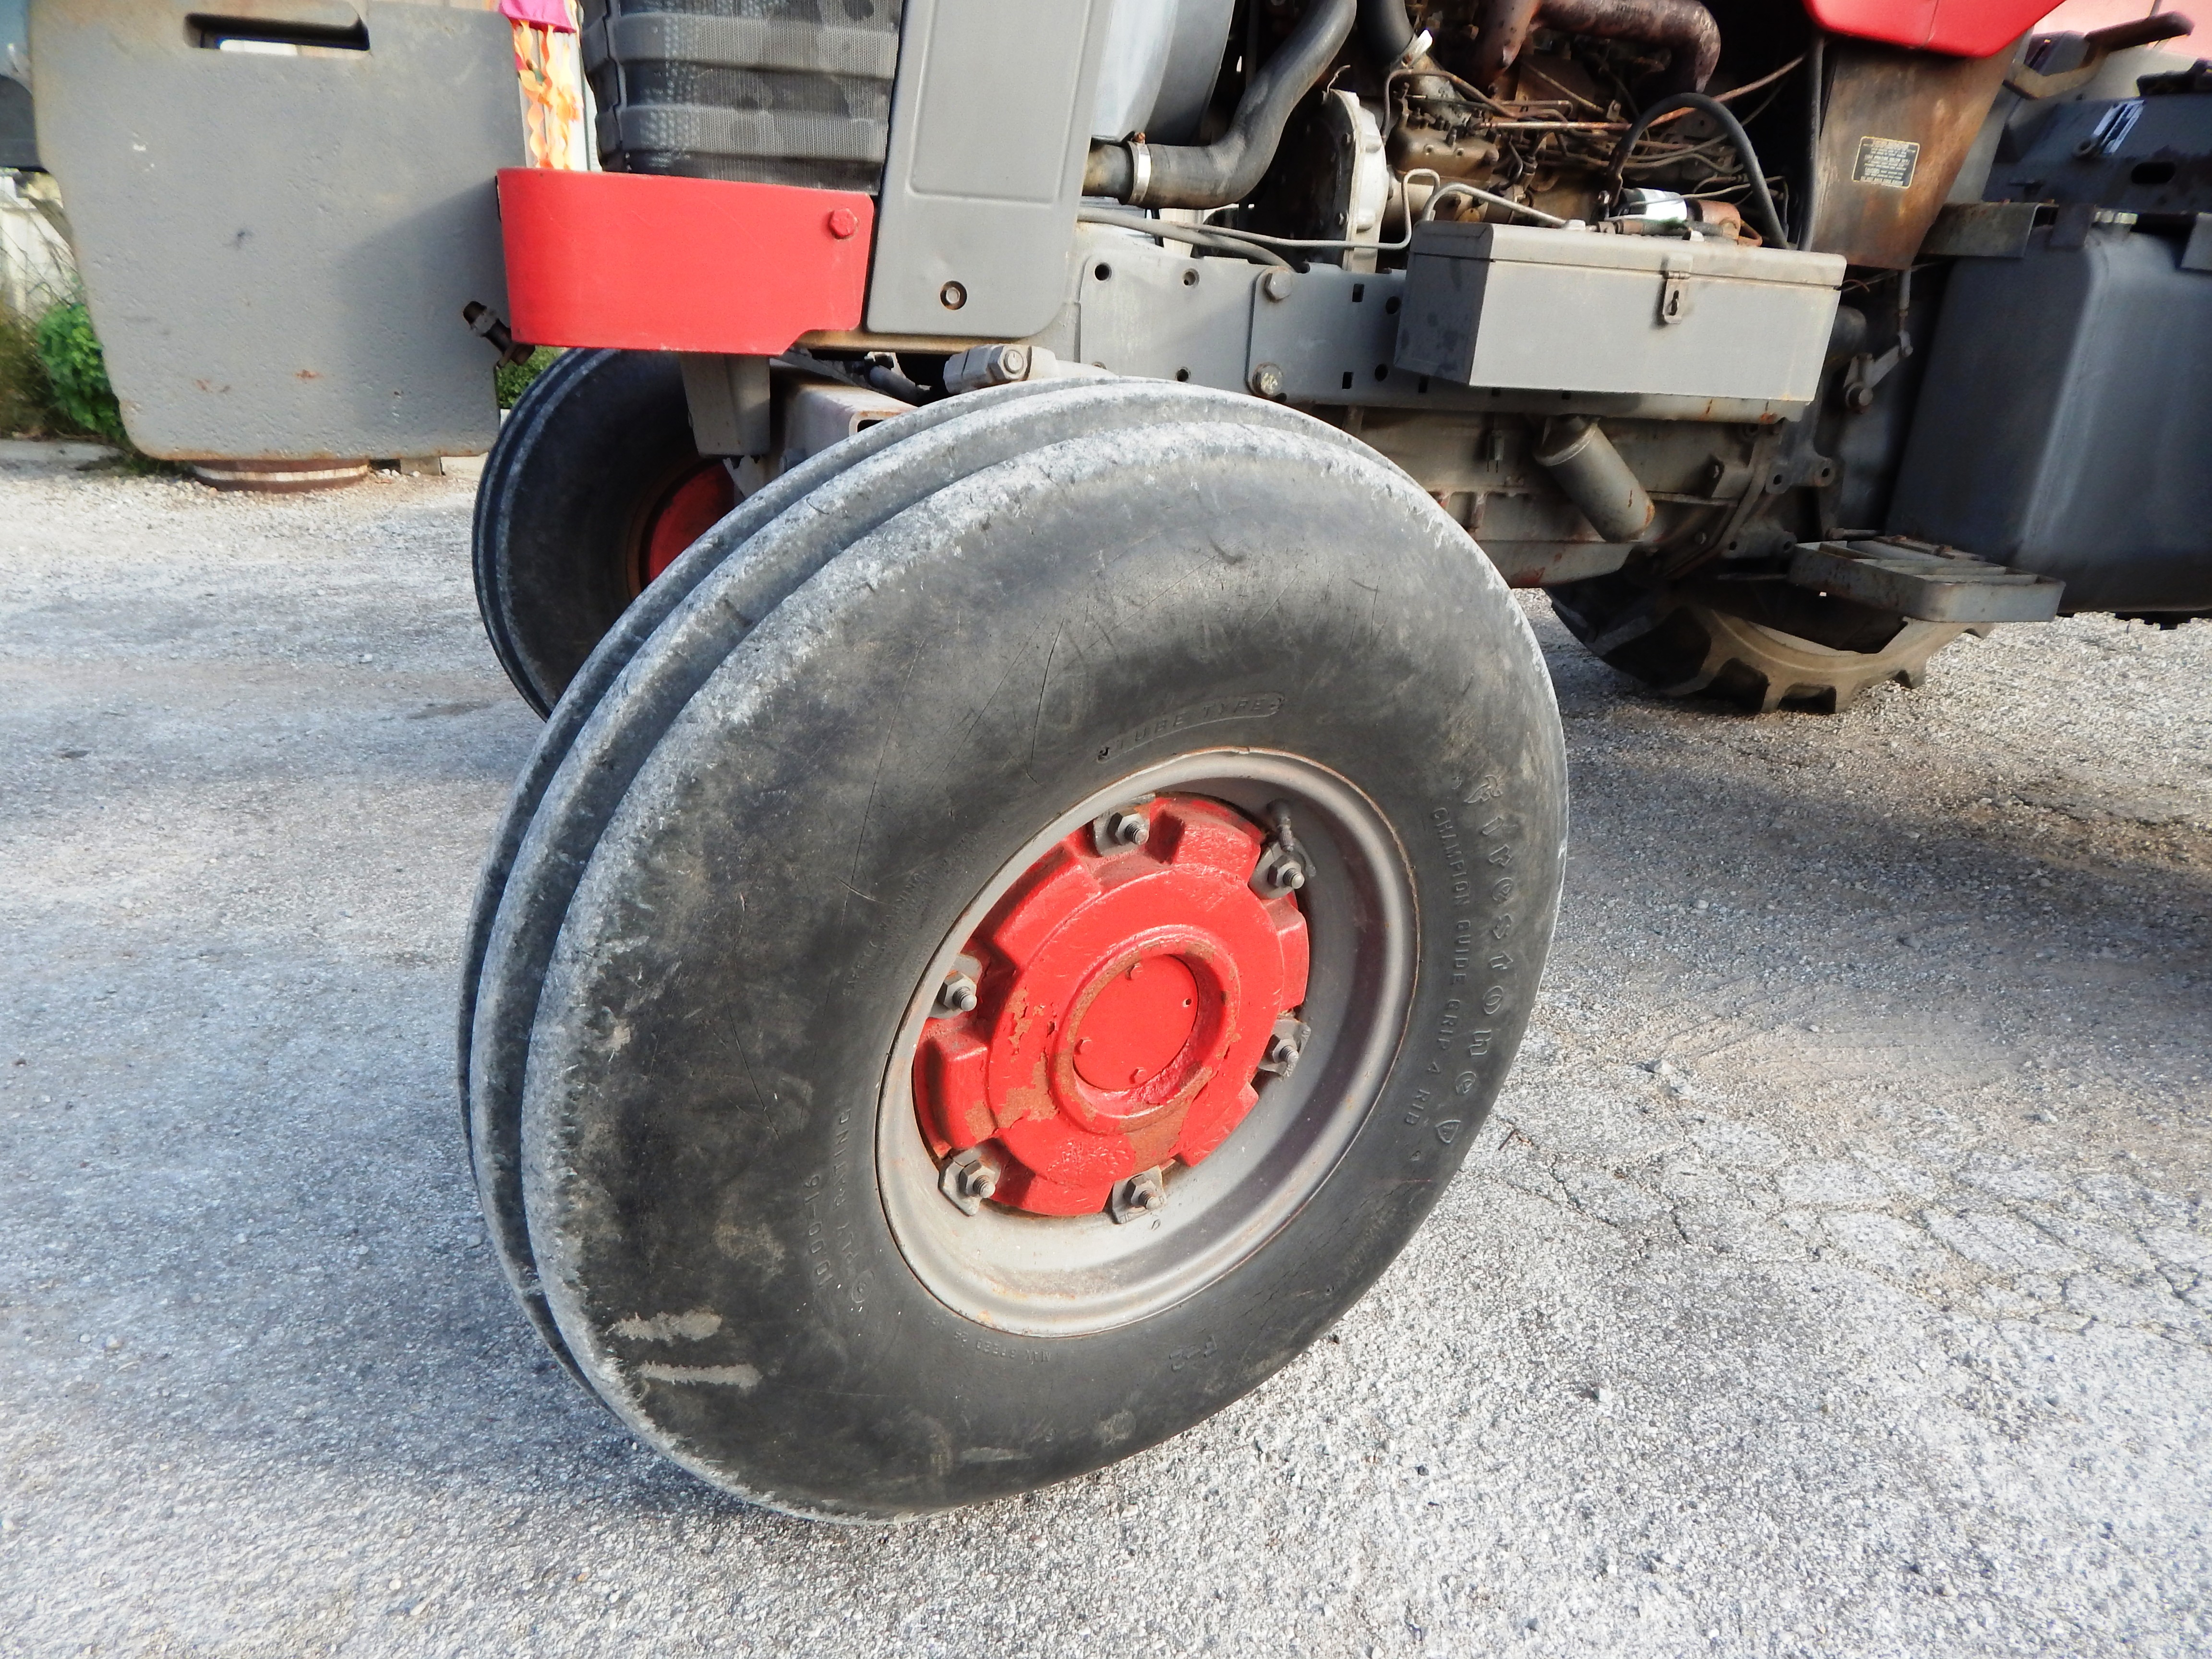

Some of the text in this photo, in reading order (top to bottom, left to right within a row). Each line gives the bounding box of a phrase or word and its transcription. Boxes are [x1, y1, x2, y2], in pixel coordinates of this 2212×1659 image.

[1203, 698, 1266, 718] TYPE
[1433, 807, 1470, 906] CHAMPION
[1452, 919, 1471, 984] GUIDE
[1438, 998, 1460, 1050] GRIP
[1405, 1089, 1431, 1125] RIB
[831, 1108, 852, 1210] RATING
[837, 1221, 859, 1265] PLY
[976, 1338, 1016, 1359] SPEED
